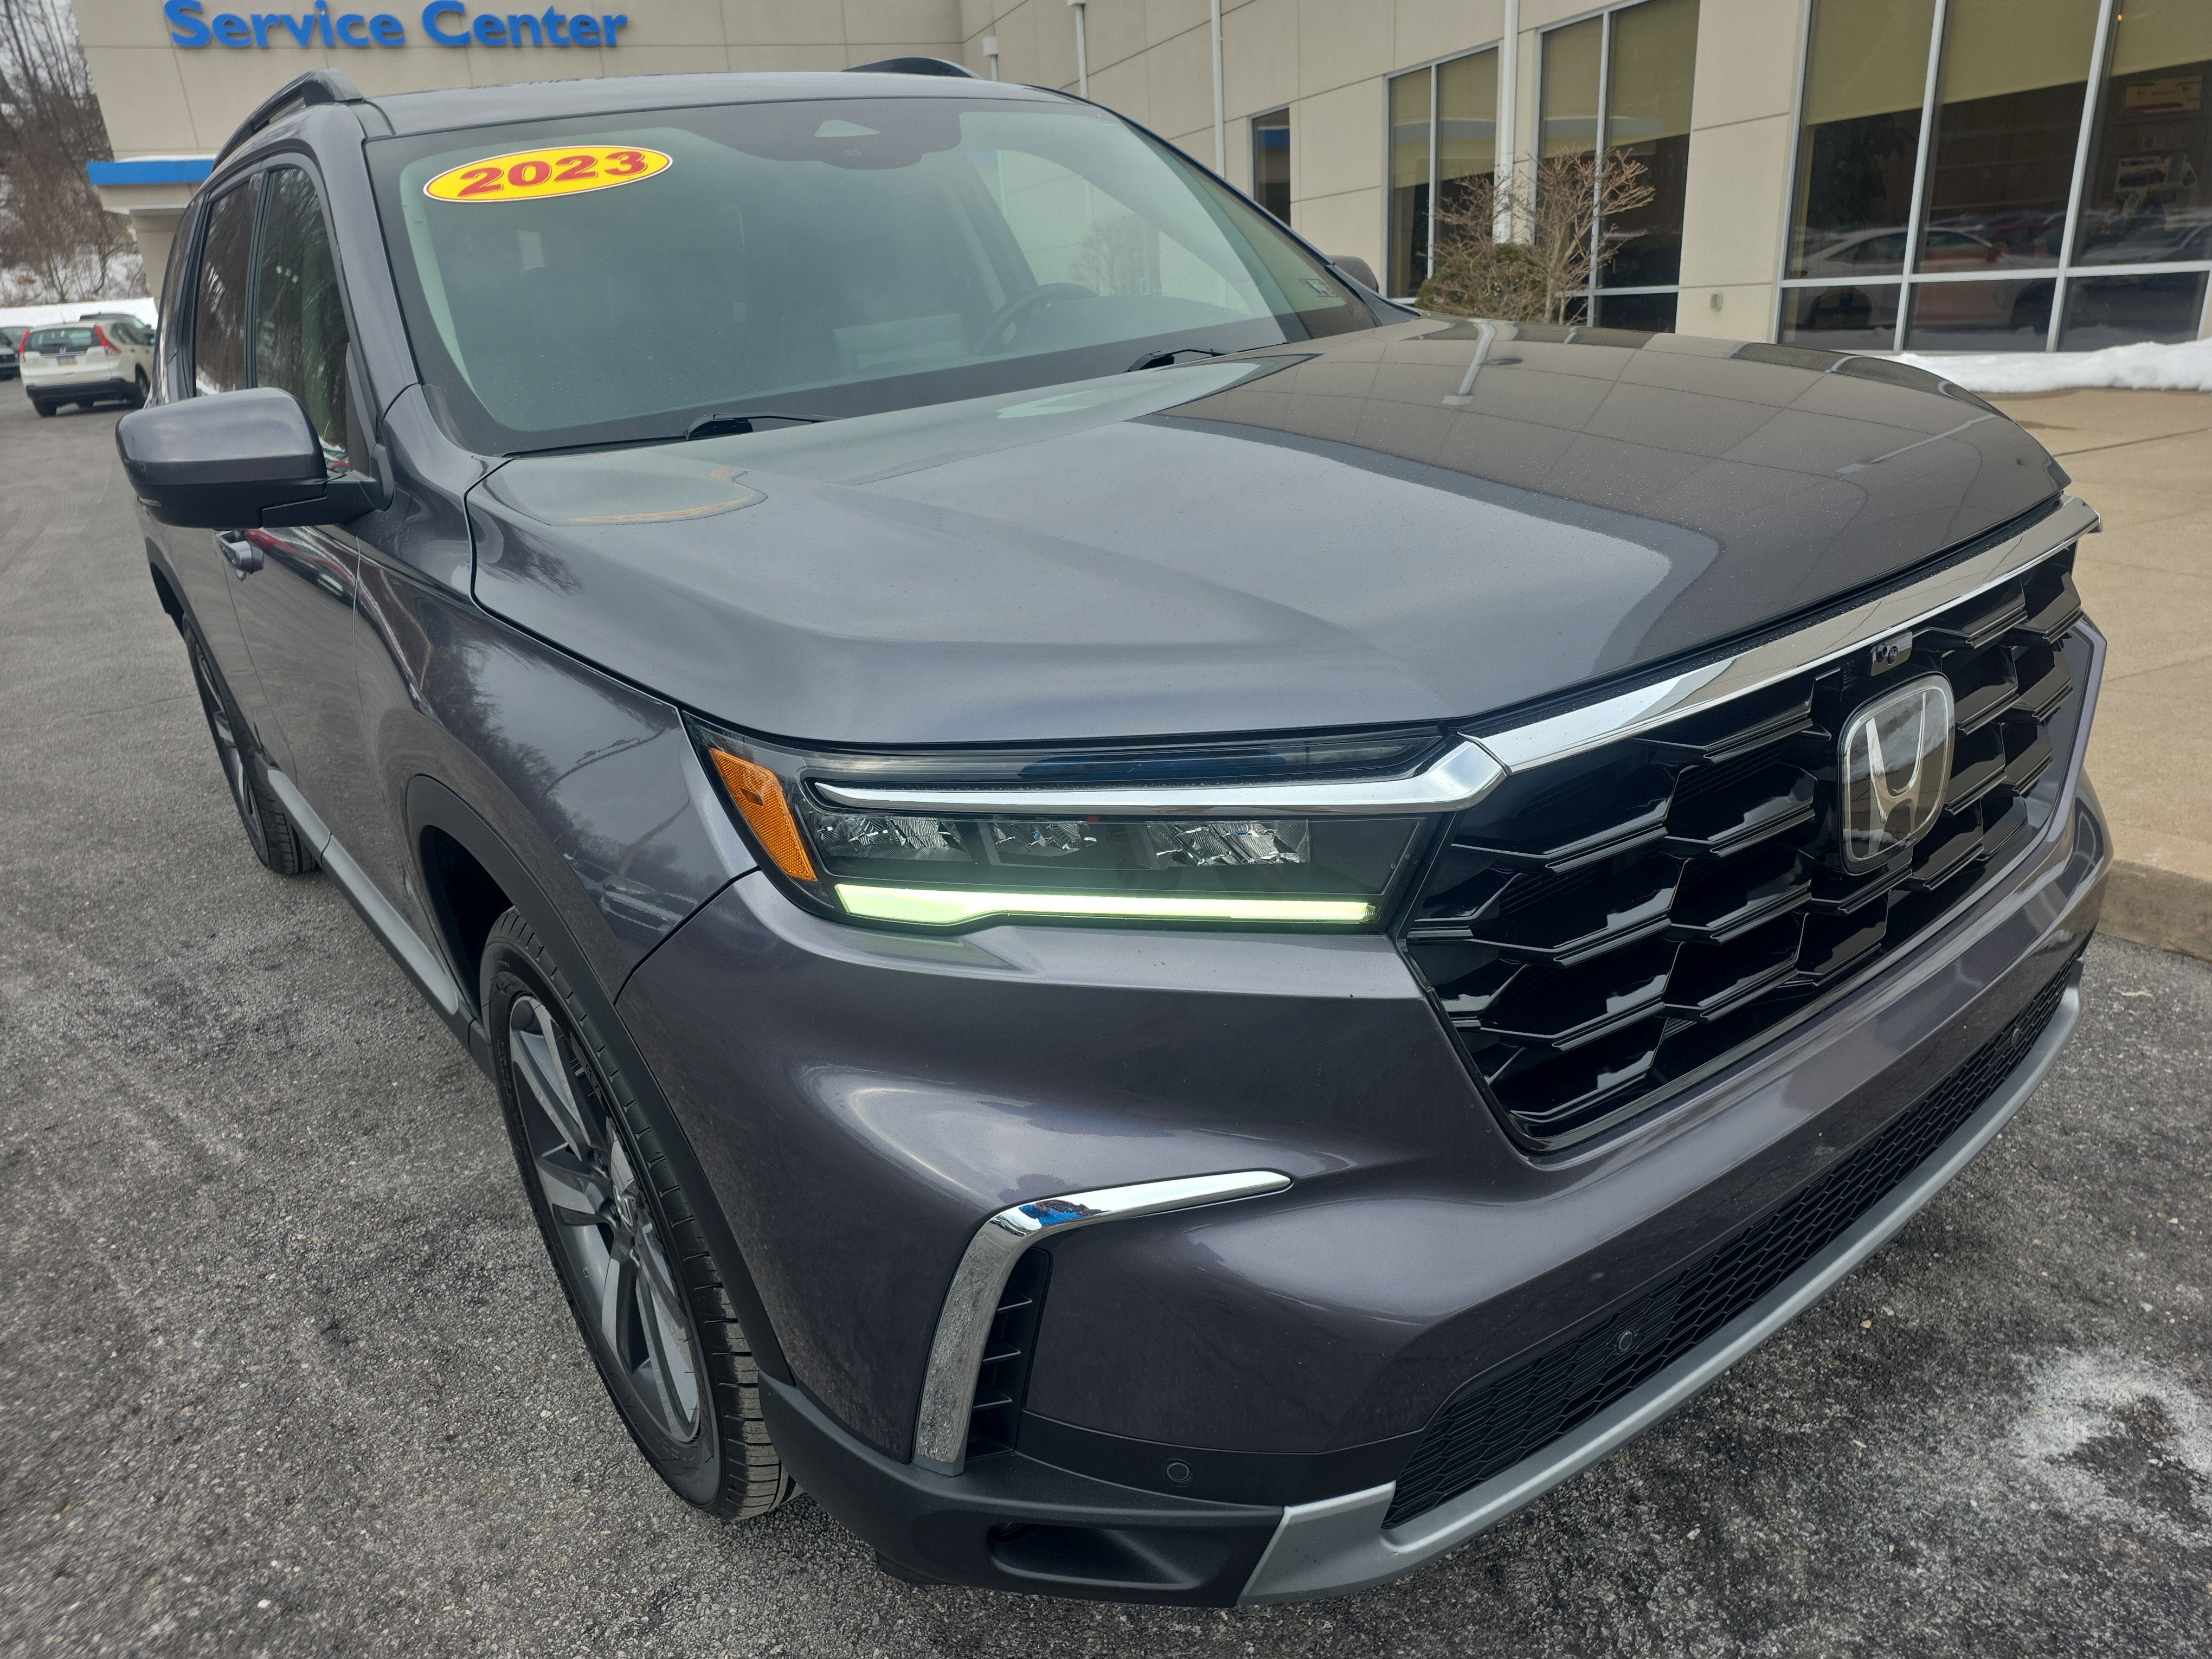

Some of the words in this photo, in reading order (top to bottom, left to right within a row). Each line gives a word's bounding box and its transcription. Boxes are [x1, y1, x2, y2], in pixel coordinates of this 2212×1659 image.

[164, 0, 406, 47] Service
[422, 0, 628, 47] Center
[458, 151, 648, 197] 2023
